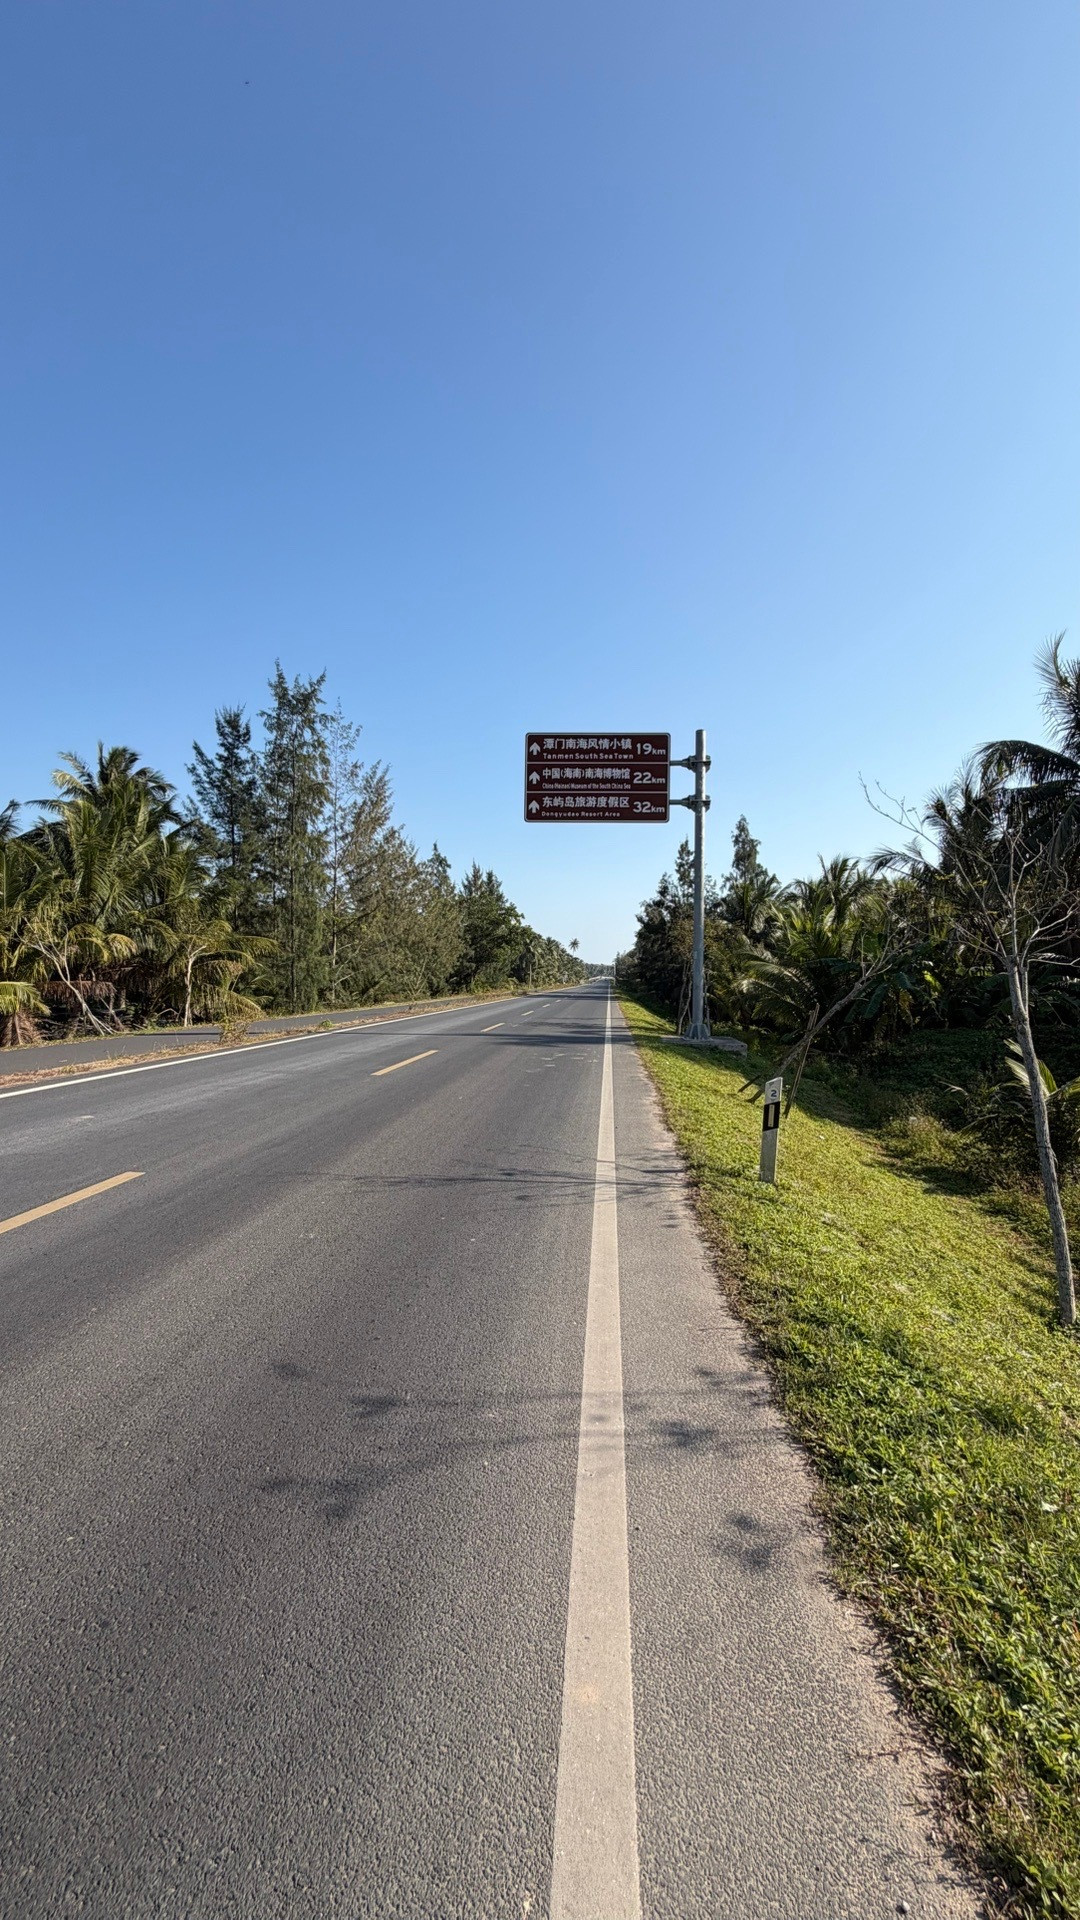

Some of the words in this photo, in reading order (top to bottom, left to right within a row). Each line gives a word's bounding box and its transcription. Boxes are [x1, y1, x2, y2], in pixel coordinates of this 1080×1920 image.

[543, 738, 632, 750] 潭门南海风情小镇
[636, 743, 666, 755] 19km
[633, 772, 666, 784] 22km
[542, 796, 630, 808] 东屿岛旅游度假区
[633, 801, 665, 813] 32km
